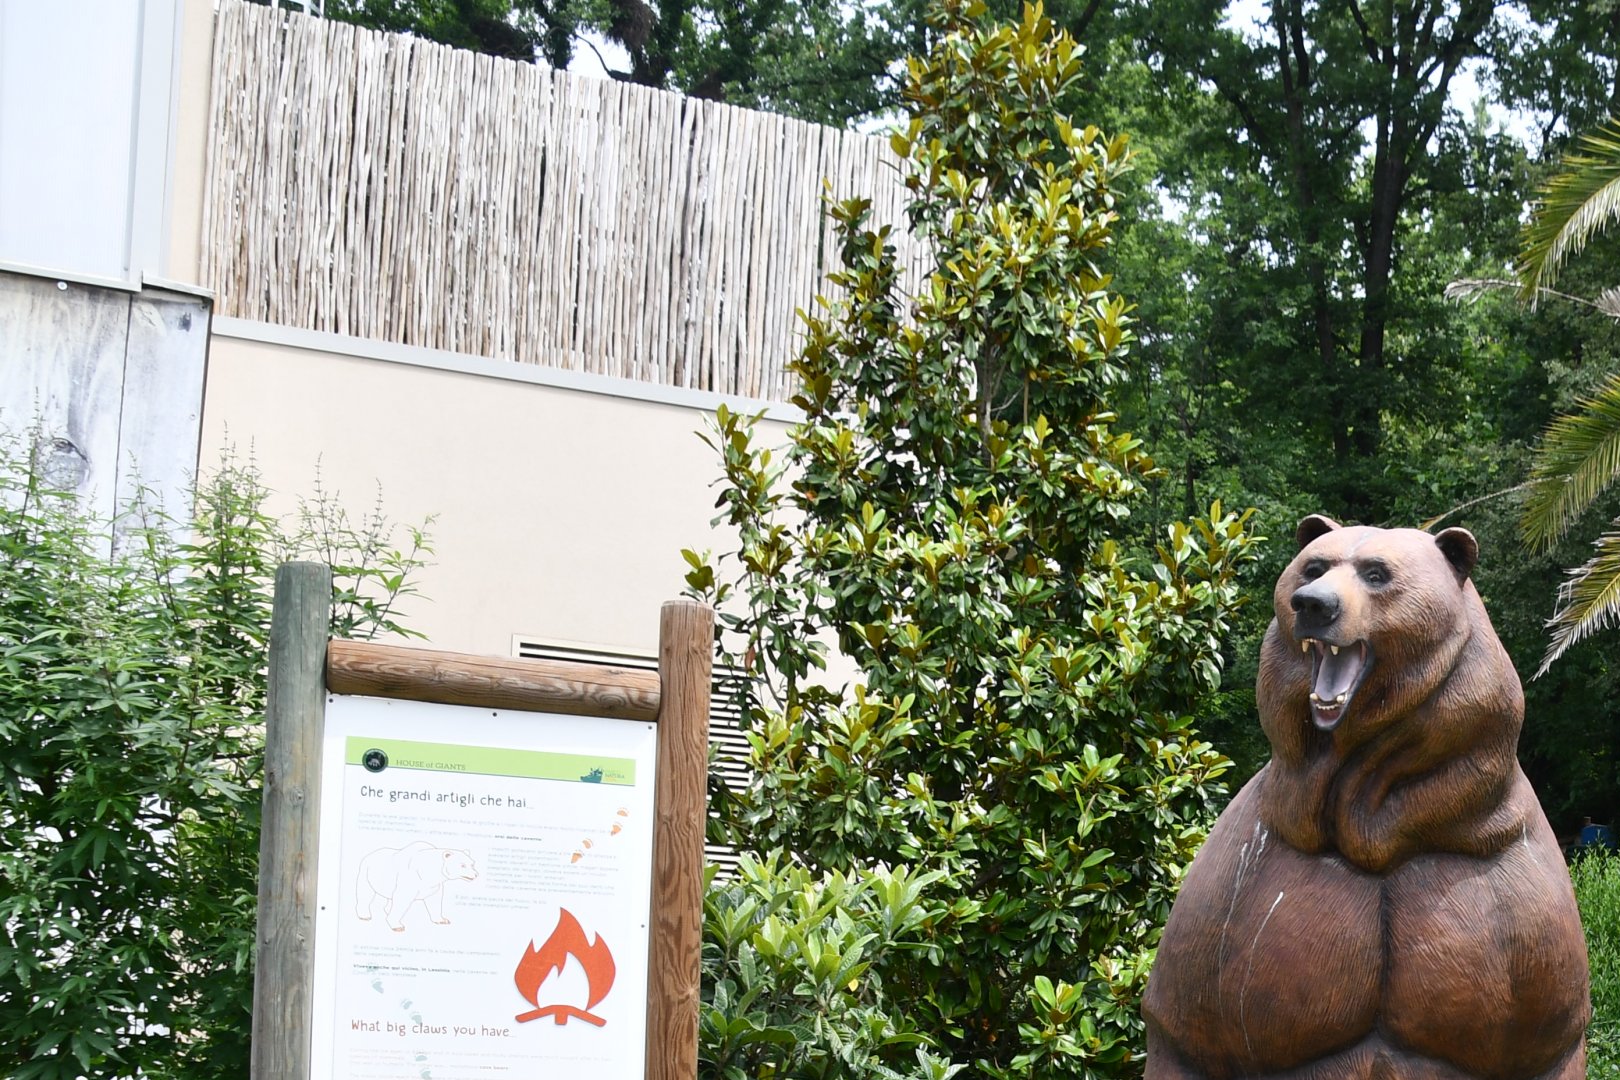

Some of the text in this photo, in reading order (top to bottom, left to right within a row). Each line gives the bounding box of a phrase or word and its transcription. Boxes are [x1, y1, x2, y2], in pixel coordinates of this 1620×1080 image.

[396, 759, 424, 768] HOUSE
[435, 762, 466, 771] GIANTS
[360, 785, 384, 798] Che
[389, 790, 431, 803] grandi
[436, 791, 475, 807] artigli
[480, 794, 502, 806] che
[351, 1019, 381, 1032] What
[386, 1021, 406, 1037] big
[412, 1022, 448, 1035] claws
[453, 1026, 476, 1037] you
